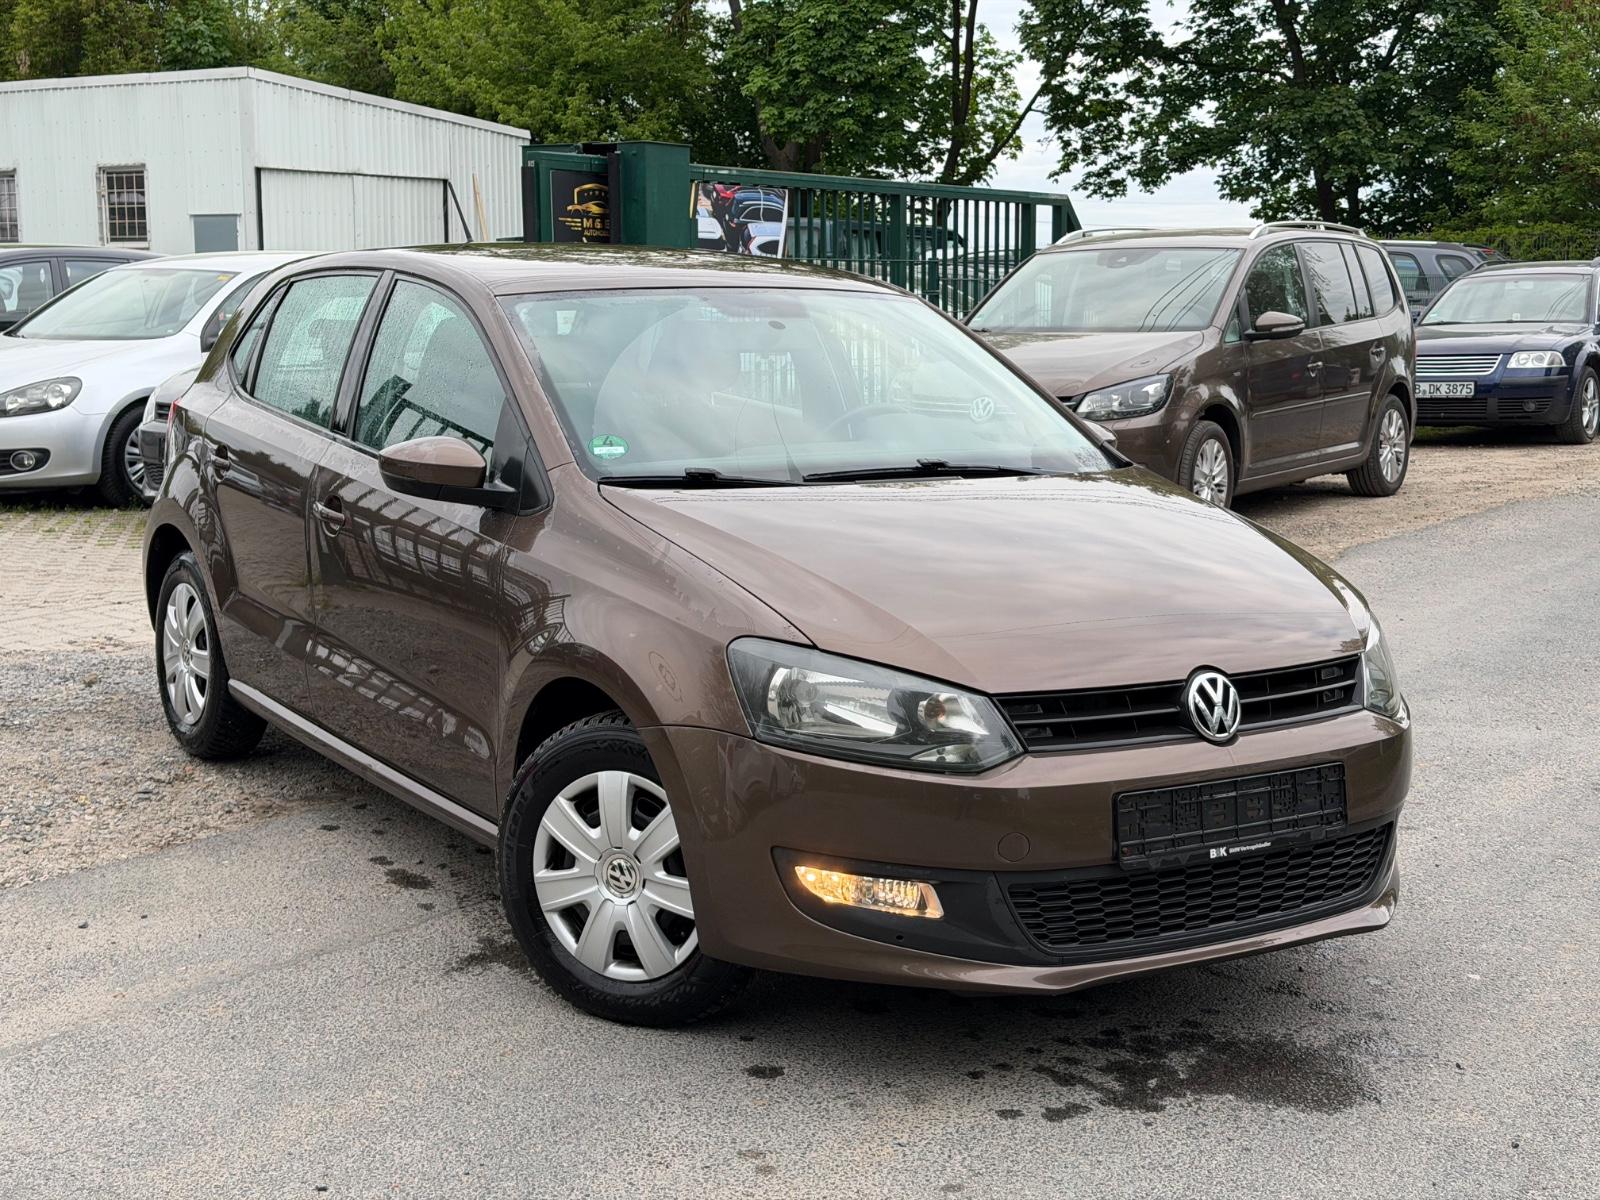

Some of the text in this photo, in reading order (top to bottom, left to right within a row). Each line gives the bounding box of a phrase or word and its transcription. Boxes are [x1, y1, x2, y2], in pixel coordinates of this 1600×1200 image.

[1428, 383, 1443, 395] DK
[1444, 383, 1473, 395] 3875
[602, 435, 613, 447] 4
[1188, 672, 1241, 740] VW
